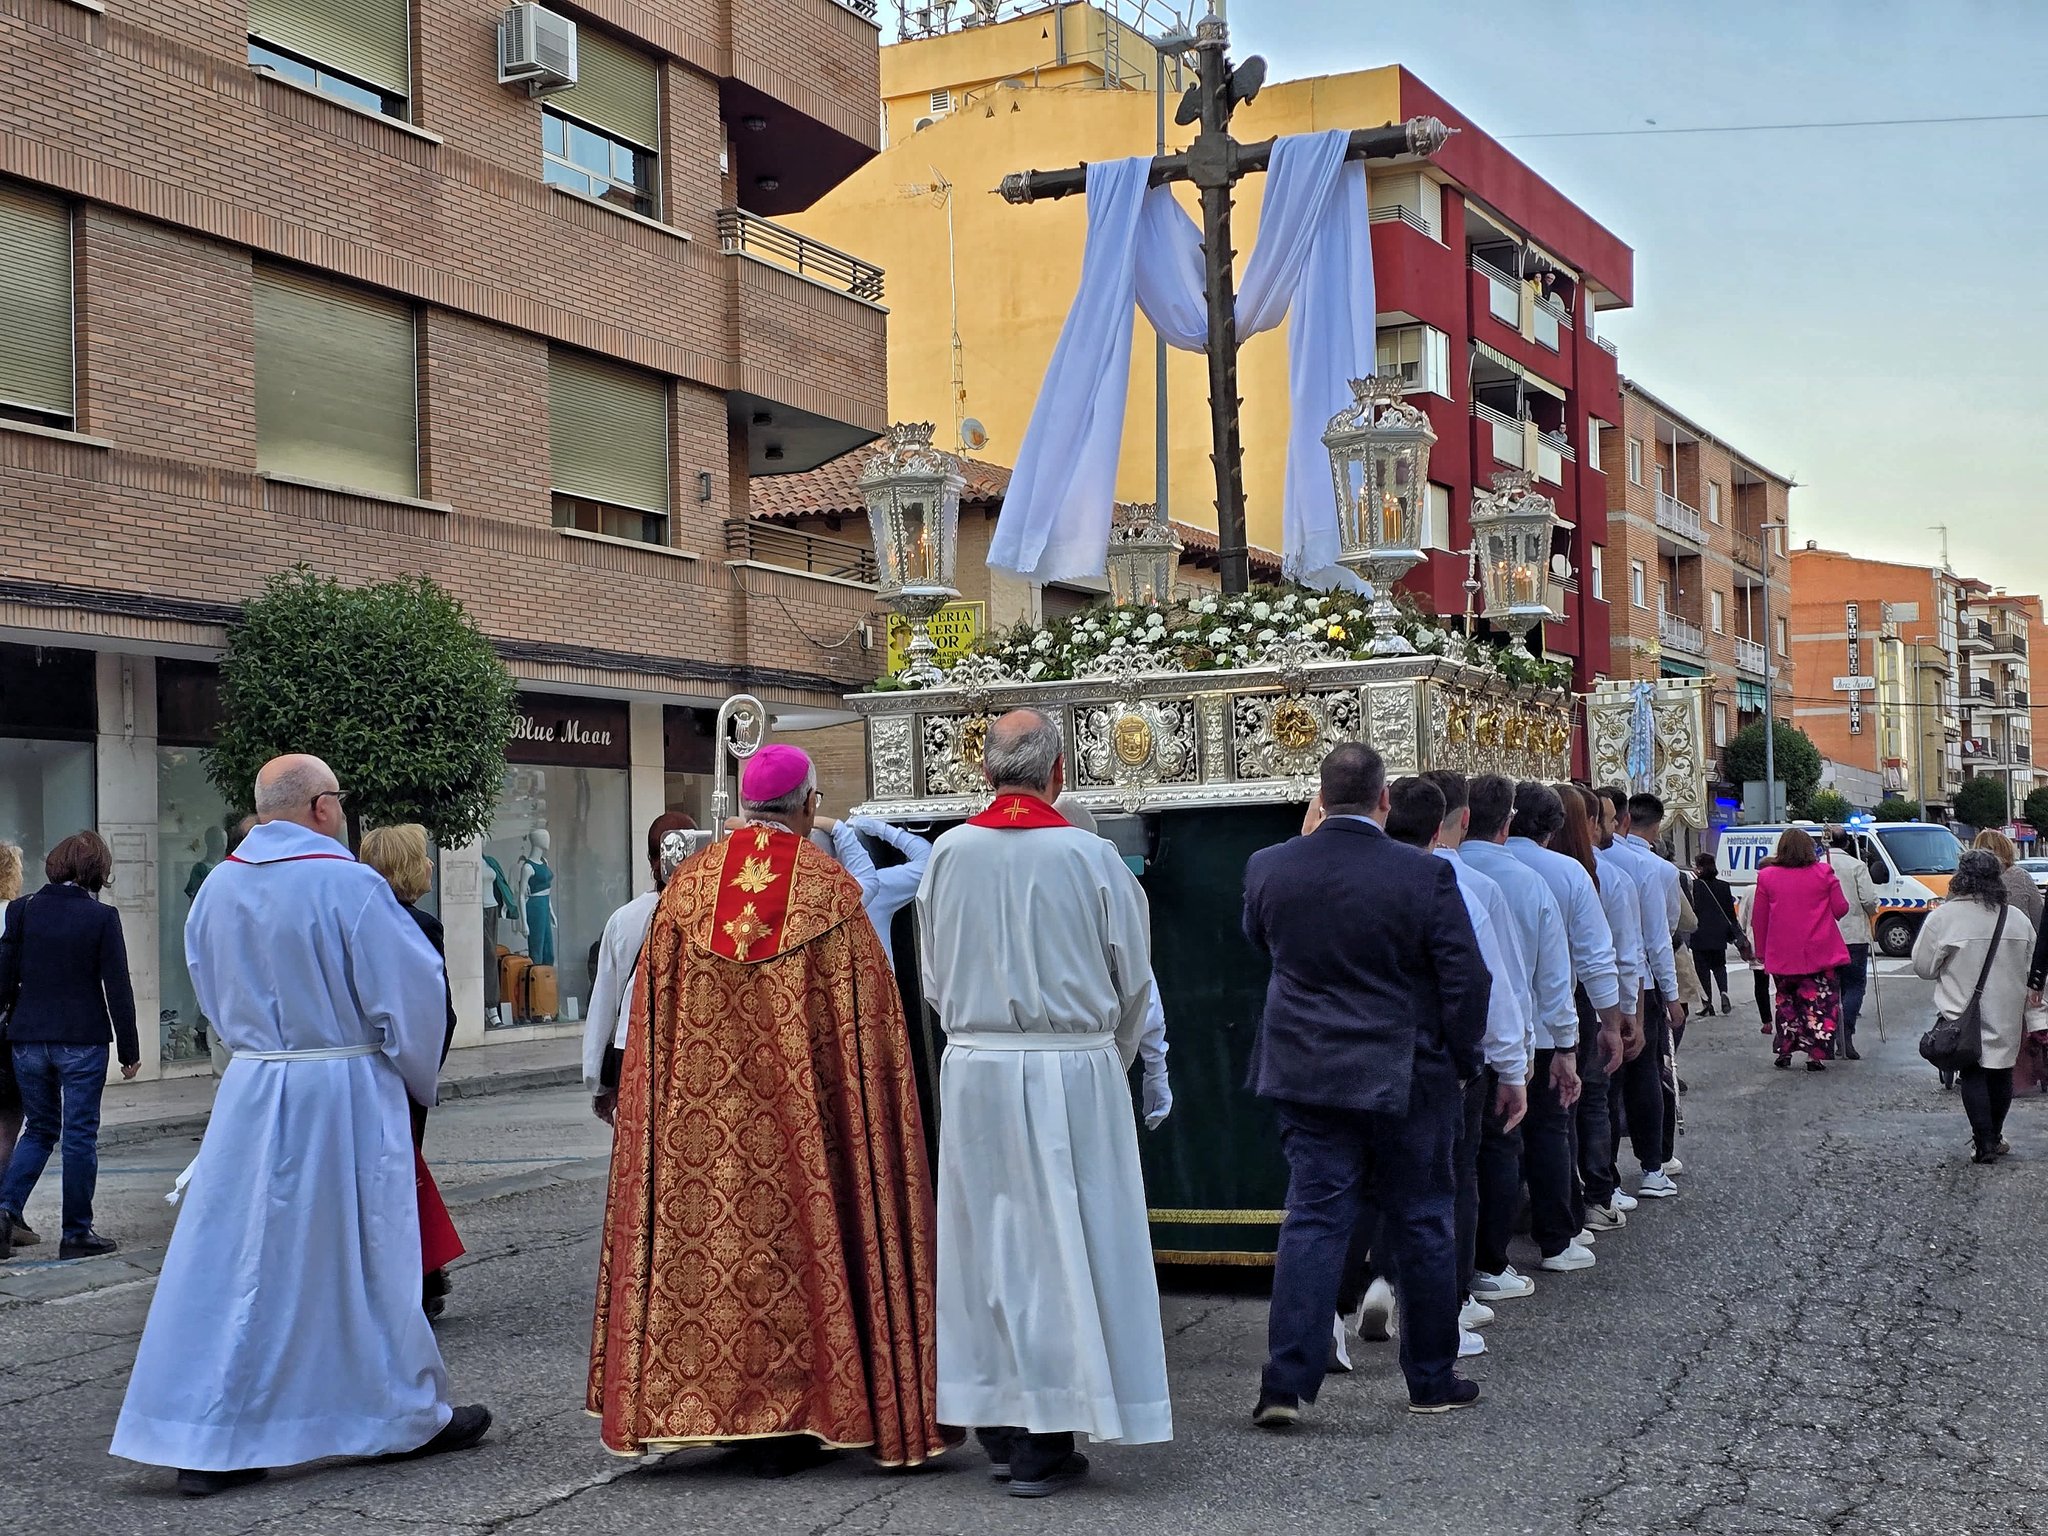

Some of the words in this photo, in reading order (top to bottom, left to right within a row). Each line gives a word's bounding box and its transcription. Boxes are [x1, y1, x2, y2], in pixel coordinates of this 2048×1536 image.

[890, 611, 971, 626] COTERIA
[1848, 607, 1857, 639] CENTRO
[510, 715, 554, 742] Blue
[561, 719, 611, 745] Moon
